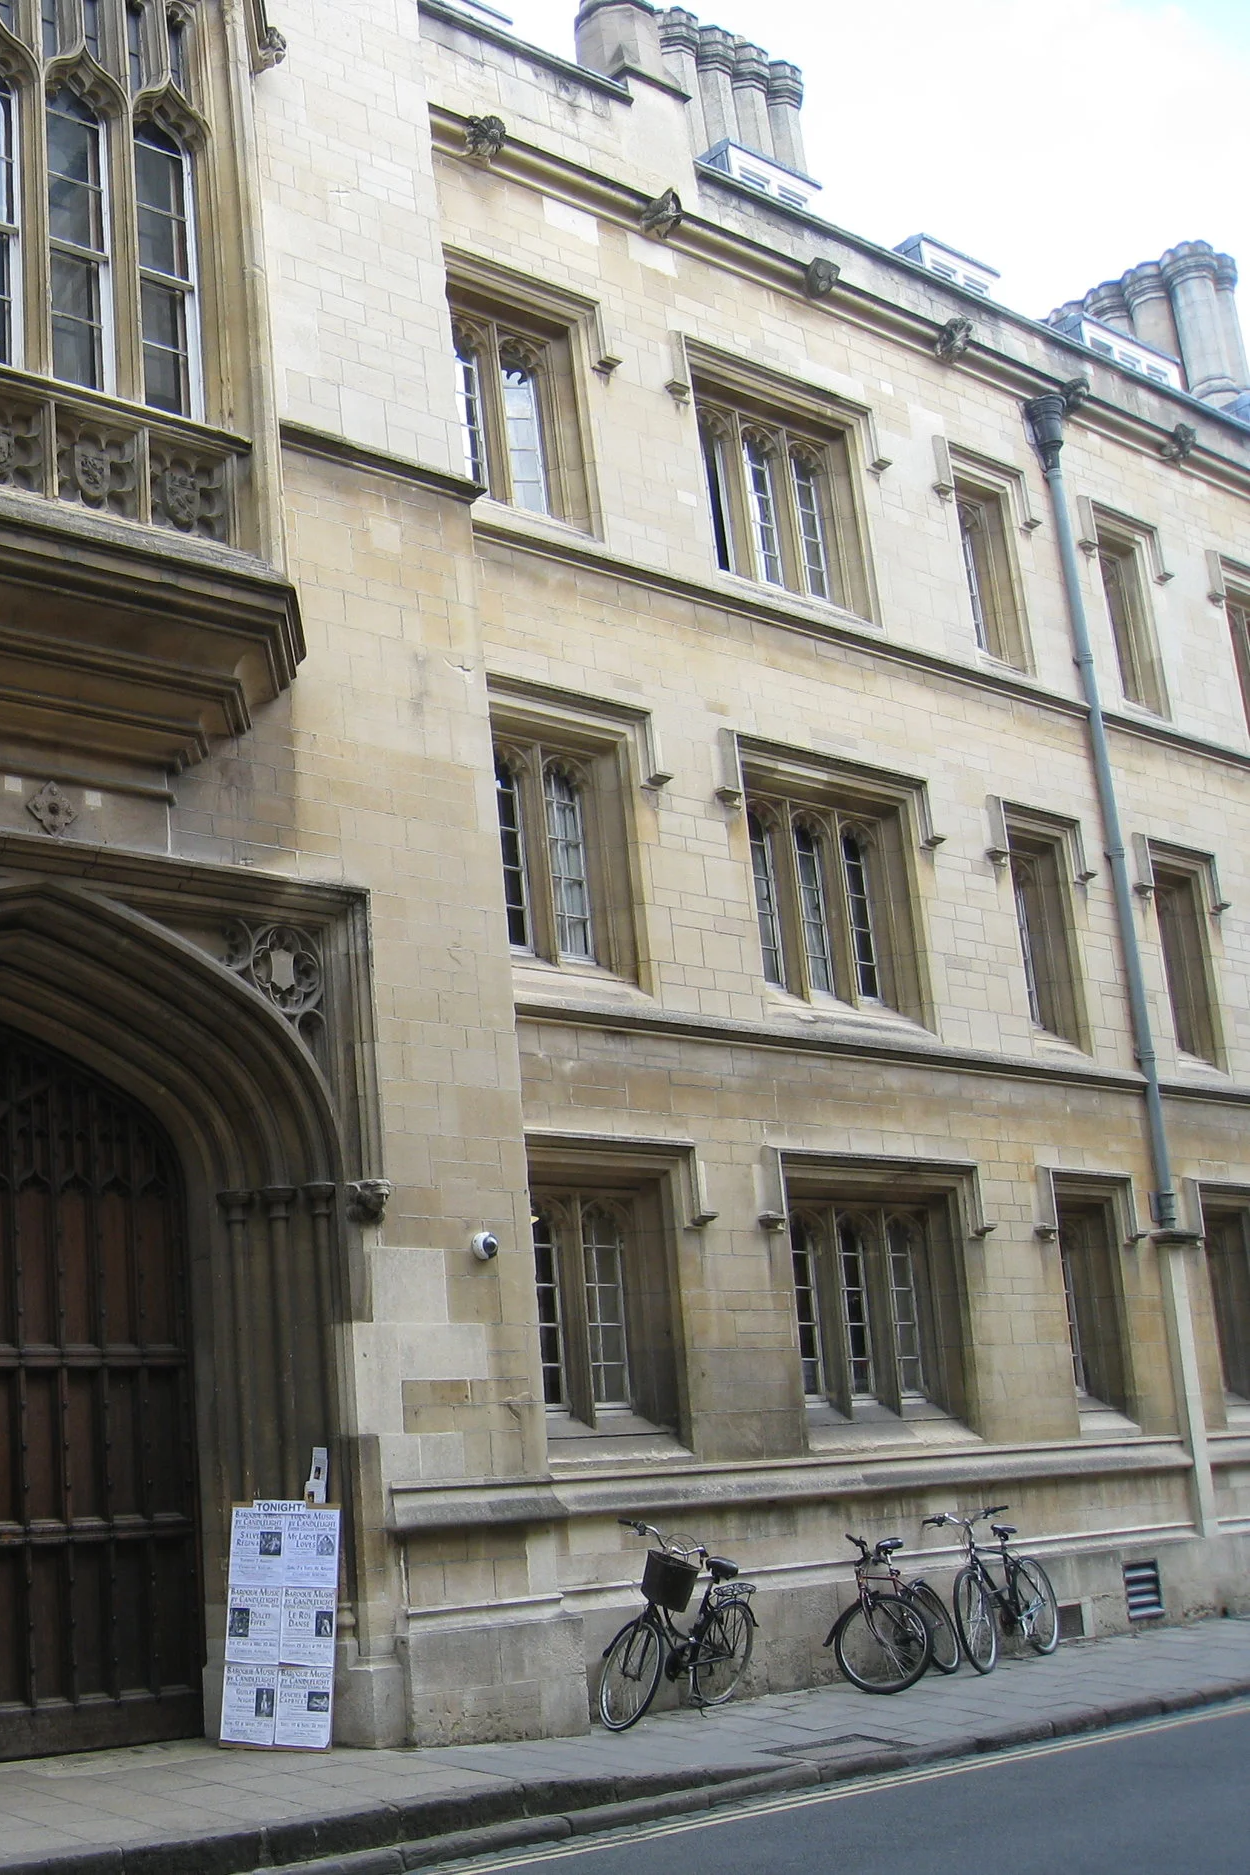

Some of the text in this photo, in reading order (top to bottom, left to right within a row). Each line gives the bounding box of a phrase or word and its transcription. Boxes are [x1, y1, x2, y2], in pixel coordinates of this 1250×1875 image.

[231, 1587, 280, 1596] BAROQUE MUSIC
[285, 1589, 335, 1598] BAROQUE MUSIC
[227, 1667, 276, 1675] BAROQUE MUSIC
[281, 1669, 308, 1678] BAROQUE
